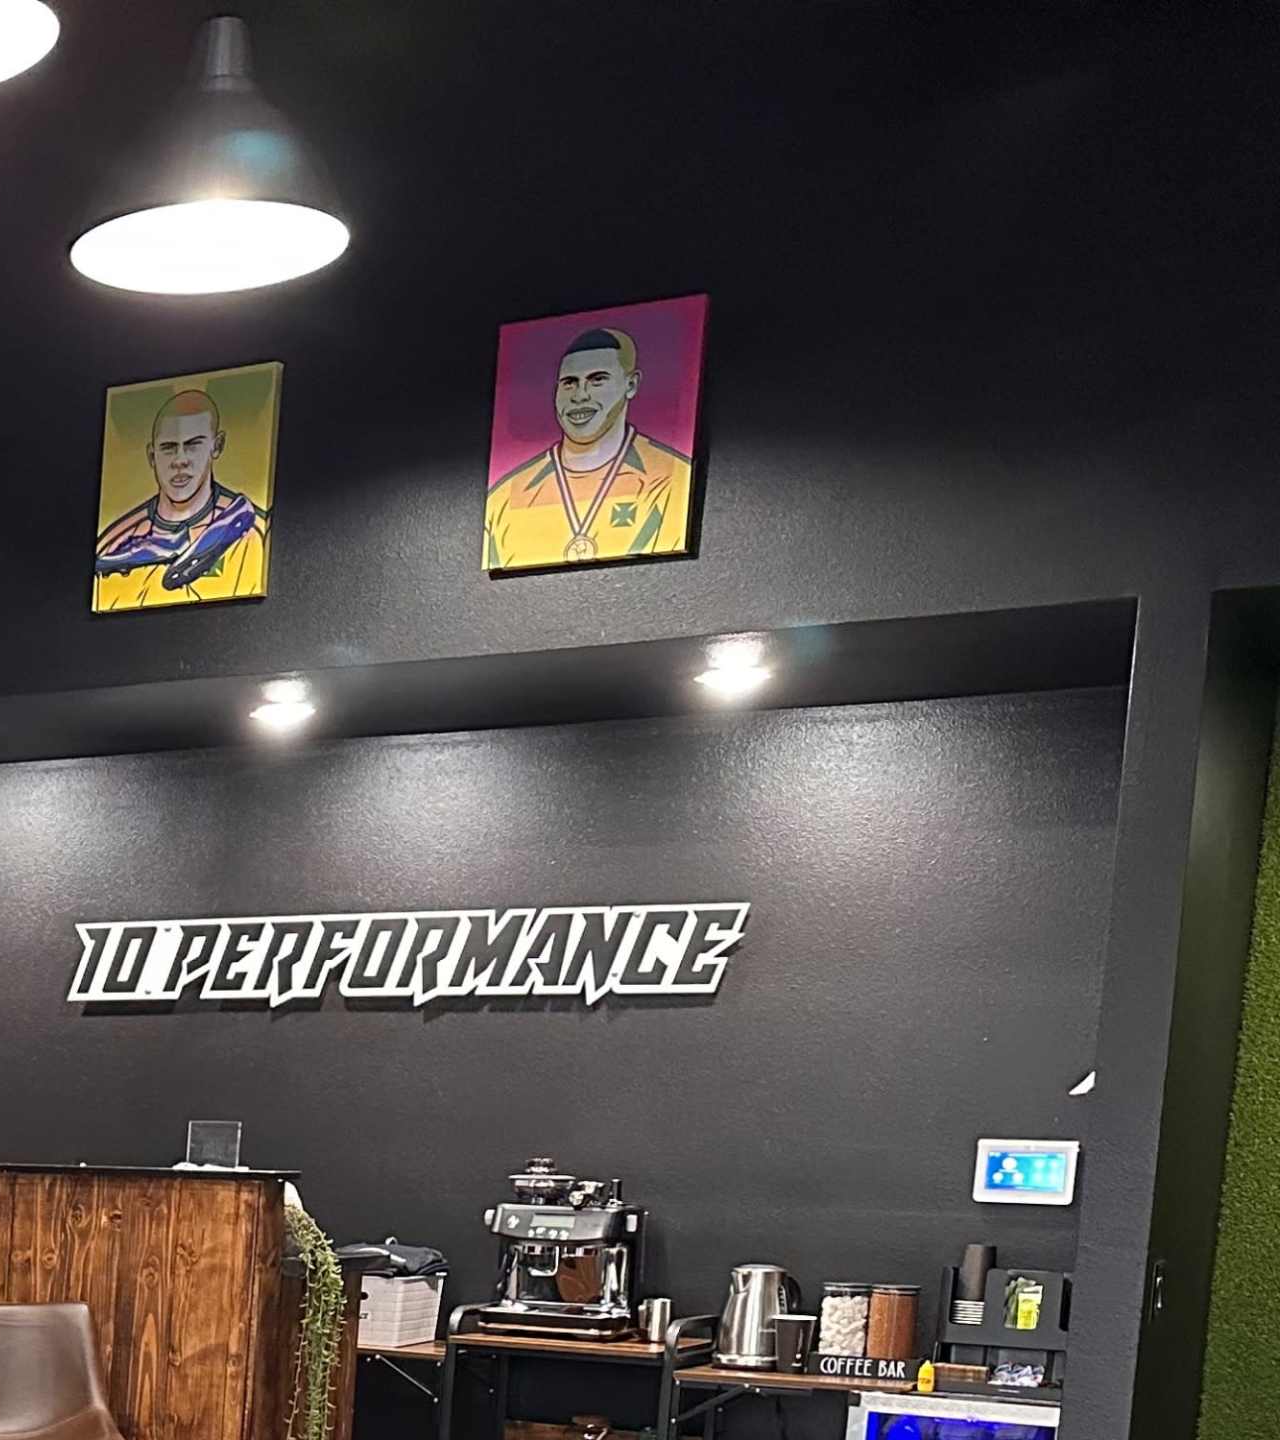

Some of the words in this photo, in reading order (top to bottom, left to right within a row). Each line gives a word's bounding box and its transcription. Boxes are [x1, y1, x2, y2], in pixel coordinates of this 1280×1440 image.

[74, 923, 157, 996] 10
[167, 905, 746, 1002] PERFORMANCE
[820, 1356, 873, 1377] COFFEE
[877, 1360, 906, 1379] BAR
